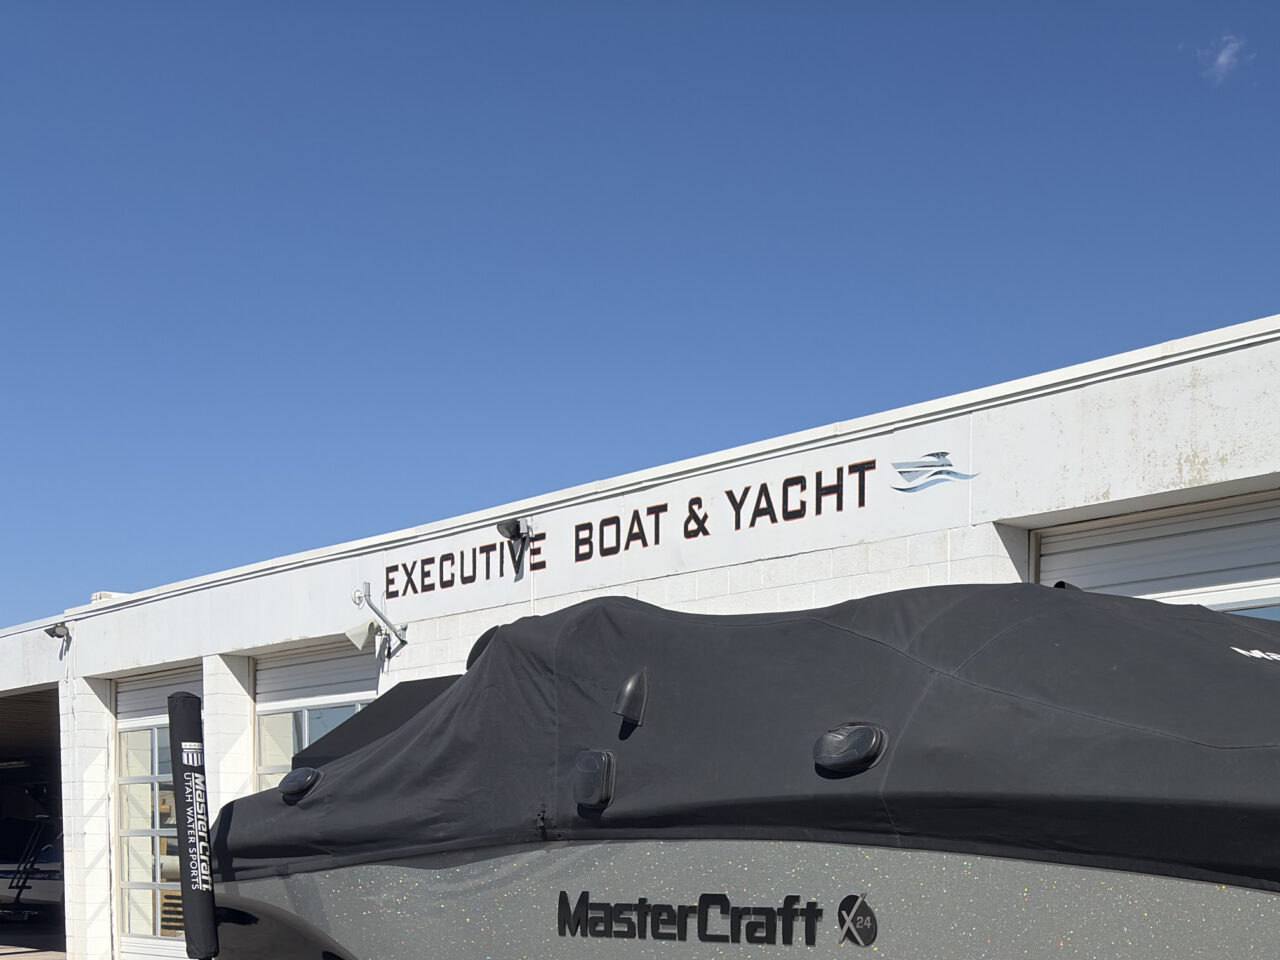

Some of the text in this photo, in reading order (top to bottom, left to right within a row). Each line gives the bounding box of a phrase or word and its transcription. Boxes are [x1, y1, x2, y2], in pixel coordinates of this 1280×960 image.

[385, 459, 877, 600] EXECUTIVE BOAT & YACHT
[184, 772, 199, 890] UTAH WATER SPORTS
[194, 772, 212, 892] MasterCraft
[557, 890, 824, 947] MasterCraft
